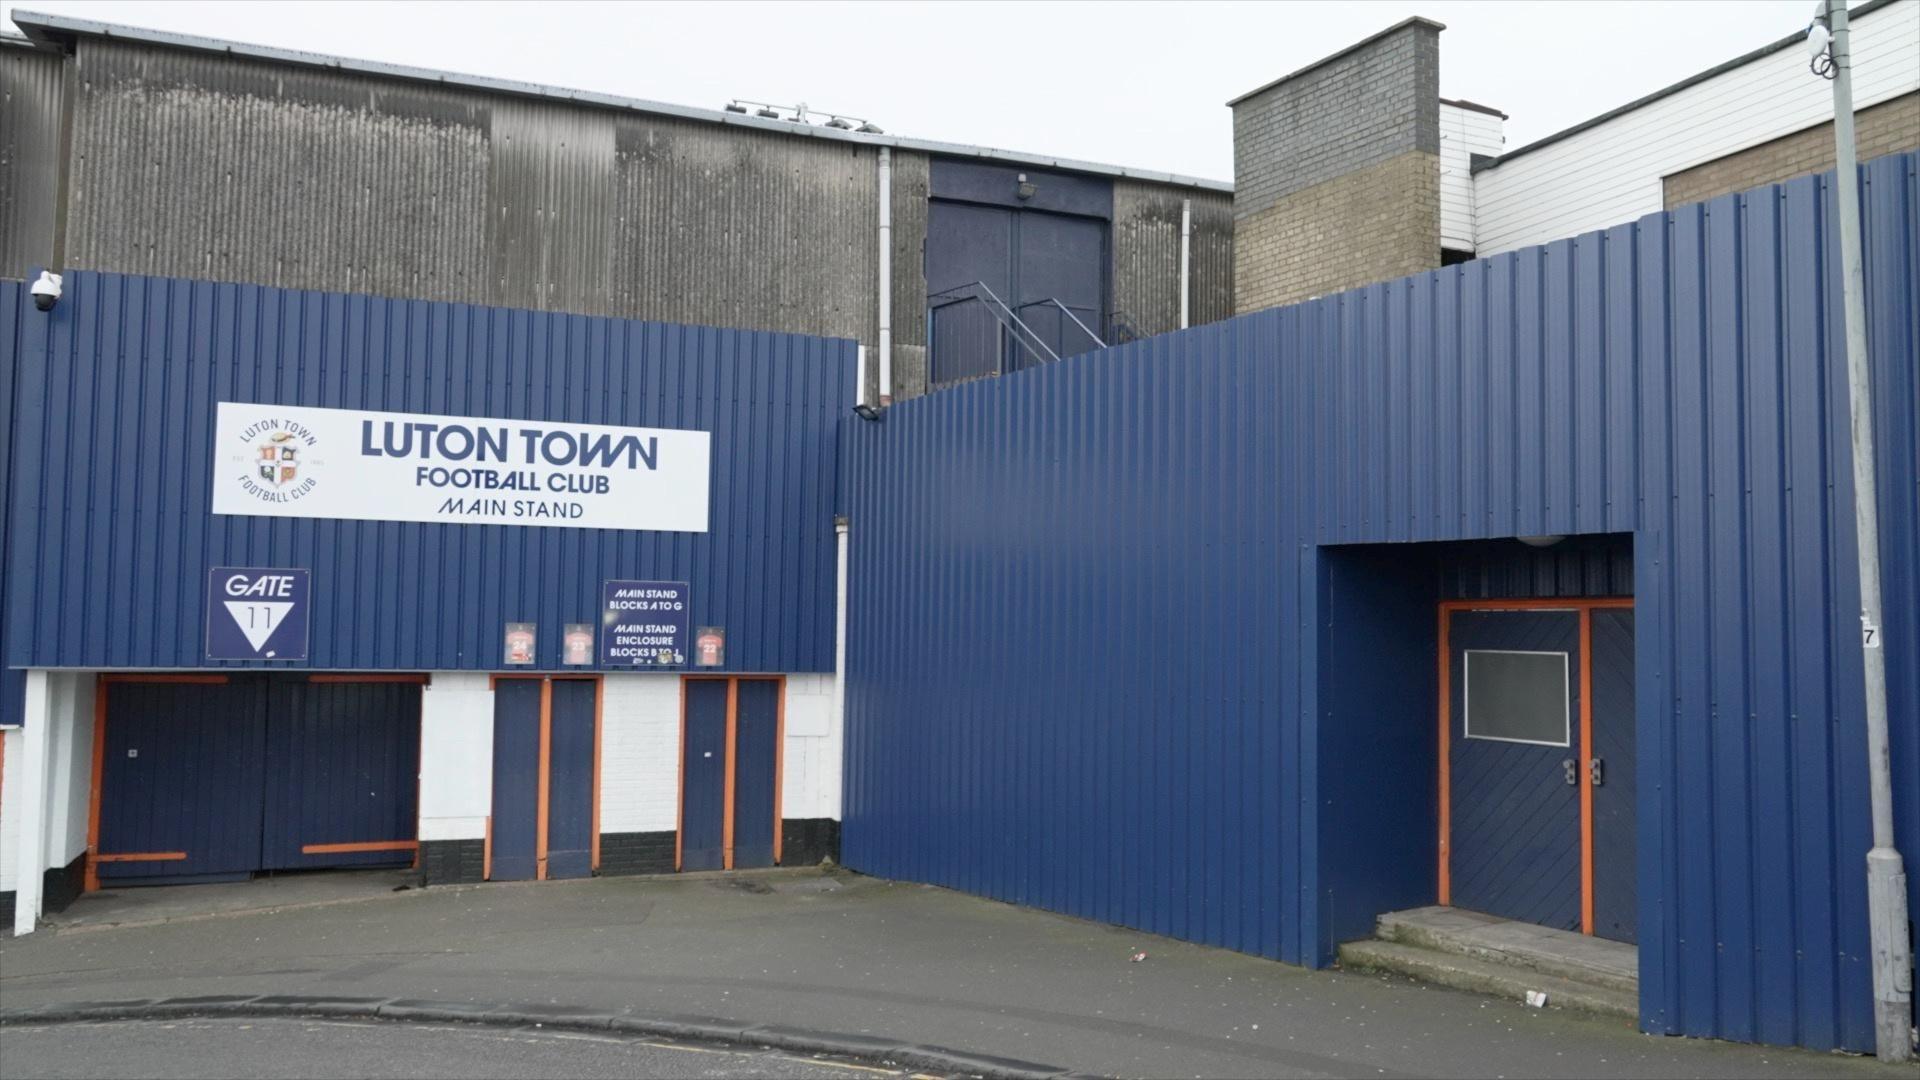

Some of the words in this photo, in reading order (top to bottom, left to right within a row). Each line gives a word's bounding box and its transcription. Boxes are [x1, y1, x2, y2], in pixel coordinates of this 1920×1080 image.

[239, 418, 279, 443] LUTON
[284, 419, 317, 446] TOWN
[361, 420, 508, 463] LUTON
[519, 429, 658, 471] TOWN
[237, 474, 289, 503] FOOTBALL
[291, 477, 317, 500] CLUB
[416, 466, 541, 492] FOOTBALL
[547, 472, 610, 495] CLUB
[437, 497, 506, 516] MAIN
[513, 500, 584, 519] STAND
[225, 574, 295, 597] GATE
[614, 588, 645, 598] MAIN
[646, 589, 678, 599] STAND
[609, 600, 648, 610] BLOCKS
[649, 601, 657, 610] A
[659, 601, 672, 610] TO
[673, 601, 683, 611] G
[247, 606, 271, 629] 11
[613, 624, 644, 633] MAIN
[645, 624, 677, 634] STAND
[1863, 629, 1875, 644] 7
[616, 636, 674, 645] ENCLOSURE
[610, 648, 649, 657] BLOCKS
[651, 648, 657, 657] B
